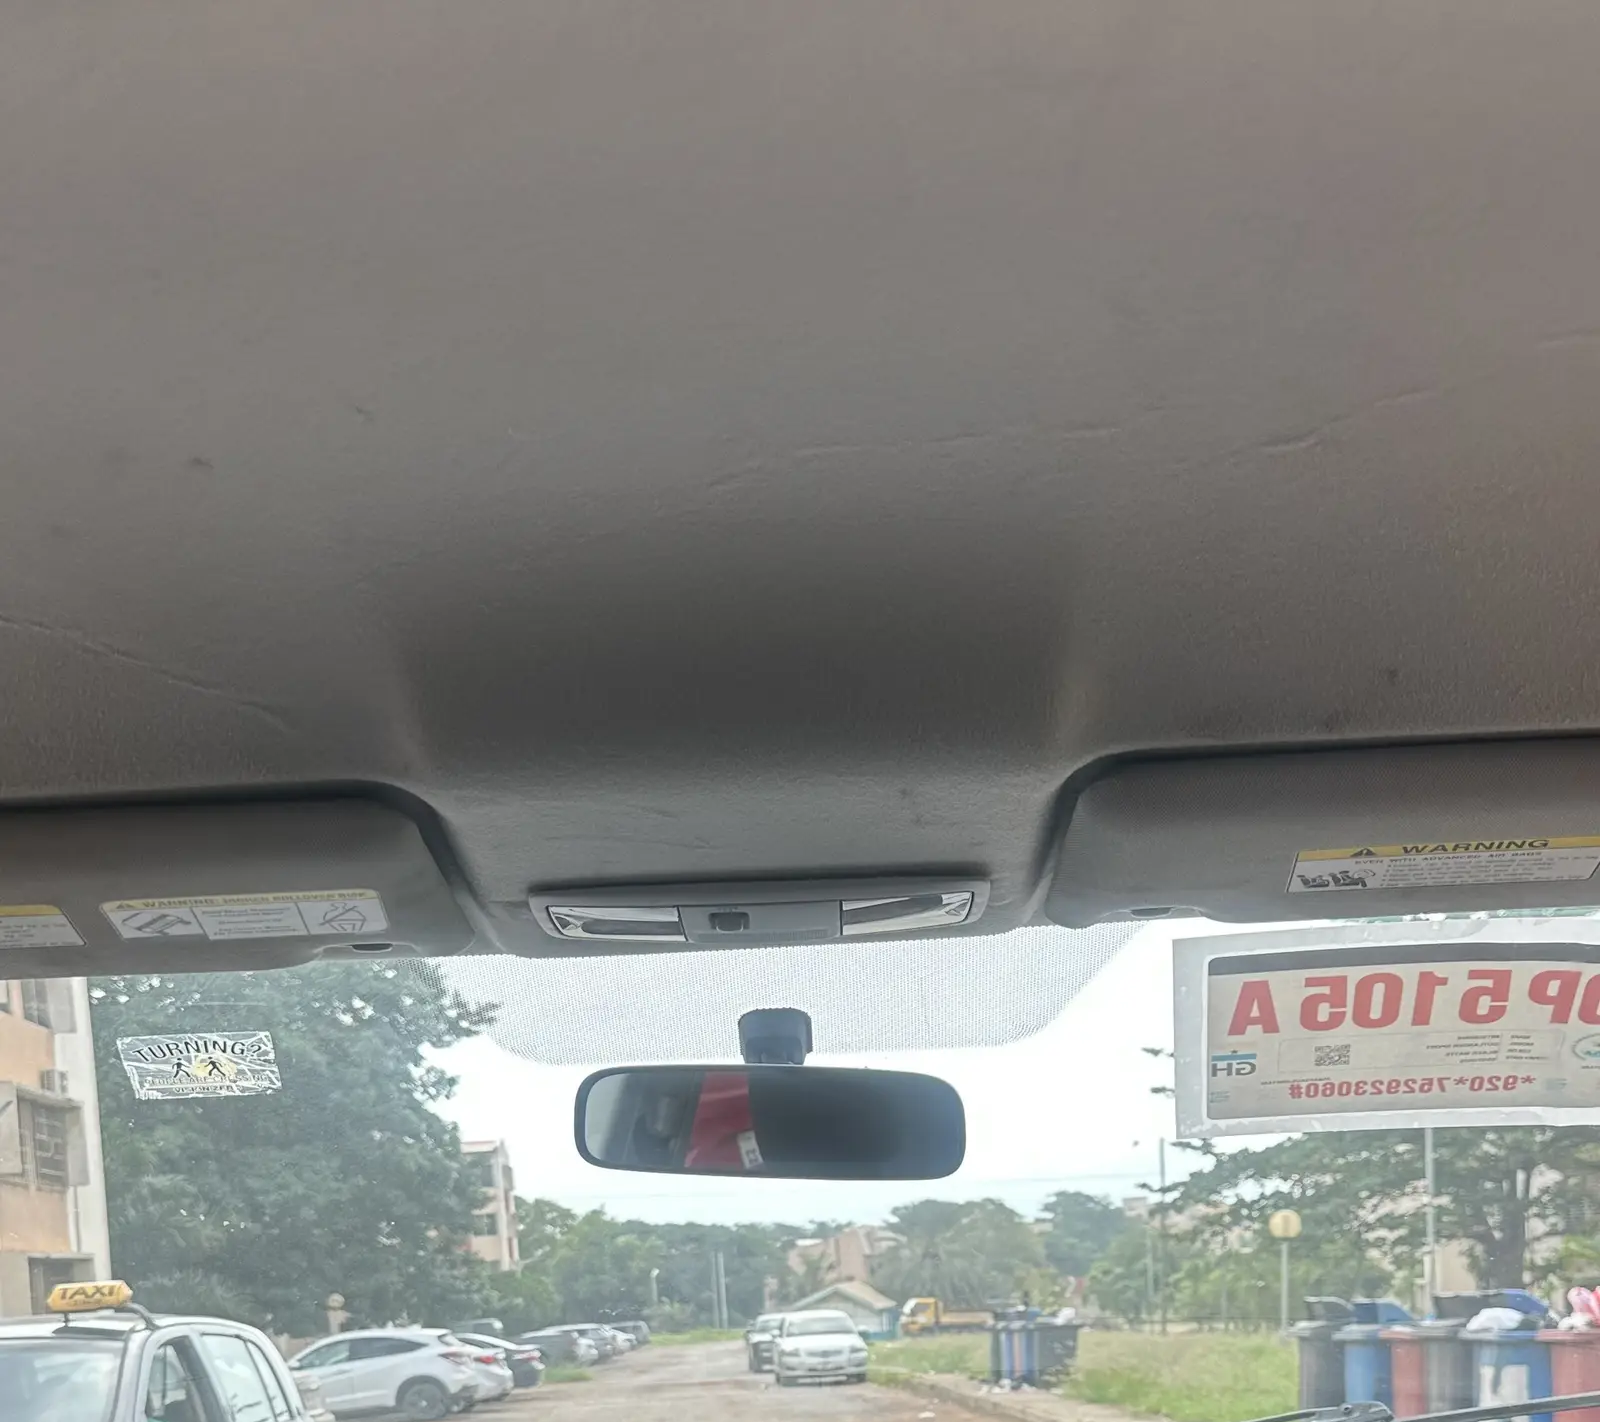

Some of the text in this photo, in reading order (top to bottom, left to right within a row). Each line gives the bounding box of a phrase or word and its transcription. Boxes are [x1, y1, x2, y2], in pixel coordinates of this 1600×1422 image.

[1402, 838, 1551, 855] WARNING
[132, 1040, 263, 1063] TURNING?
[59, 1285, 115, 1300] TAXI
